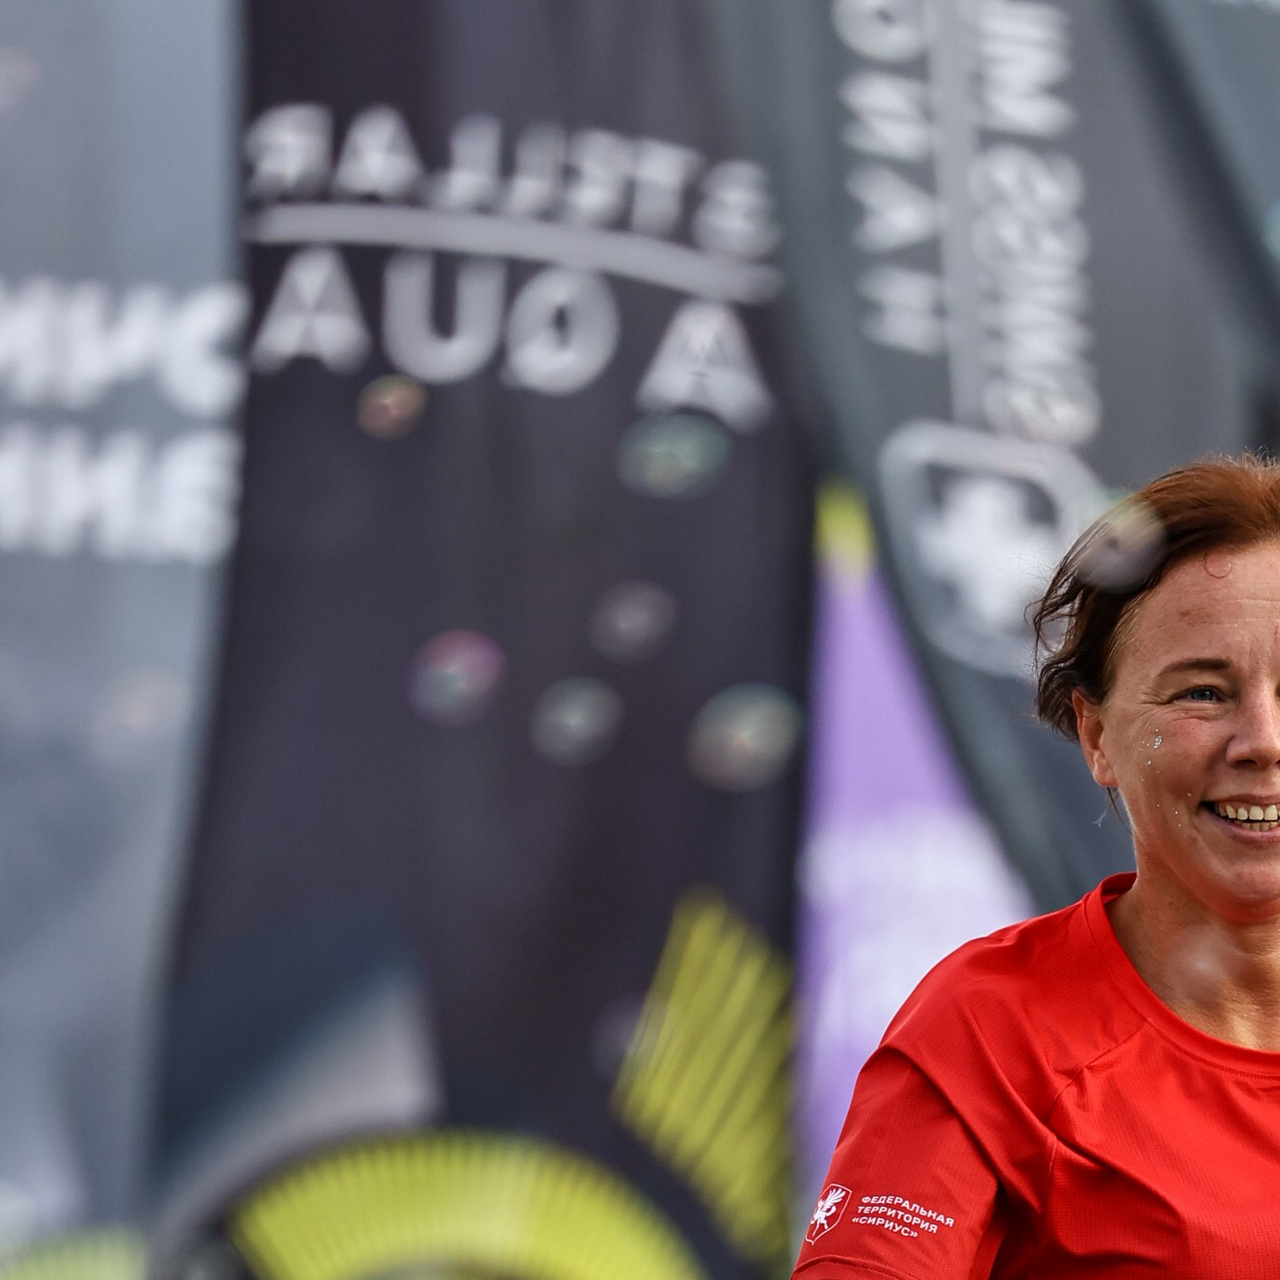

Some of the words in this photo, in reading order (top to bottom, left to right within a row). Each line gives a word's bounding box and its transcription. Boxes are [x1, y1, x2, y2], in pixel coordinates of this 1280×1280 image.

[857, 1206, 938, 1234] ТЕРРИТОРИЯ
[861, 1195, 955, 1228] ФЕДЕРАЛЬНАЯ
[852, 1216, 919, 1238] «СИРИУС»
